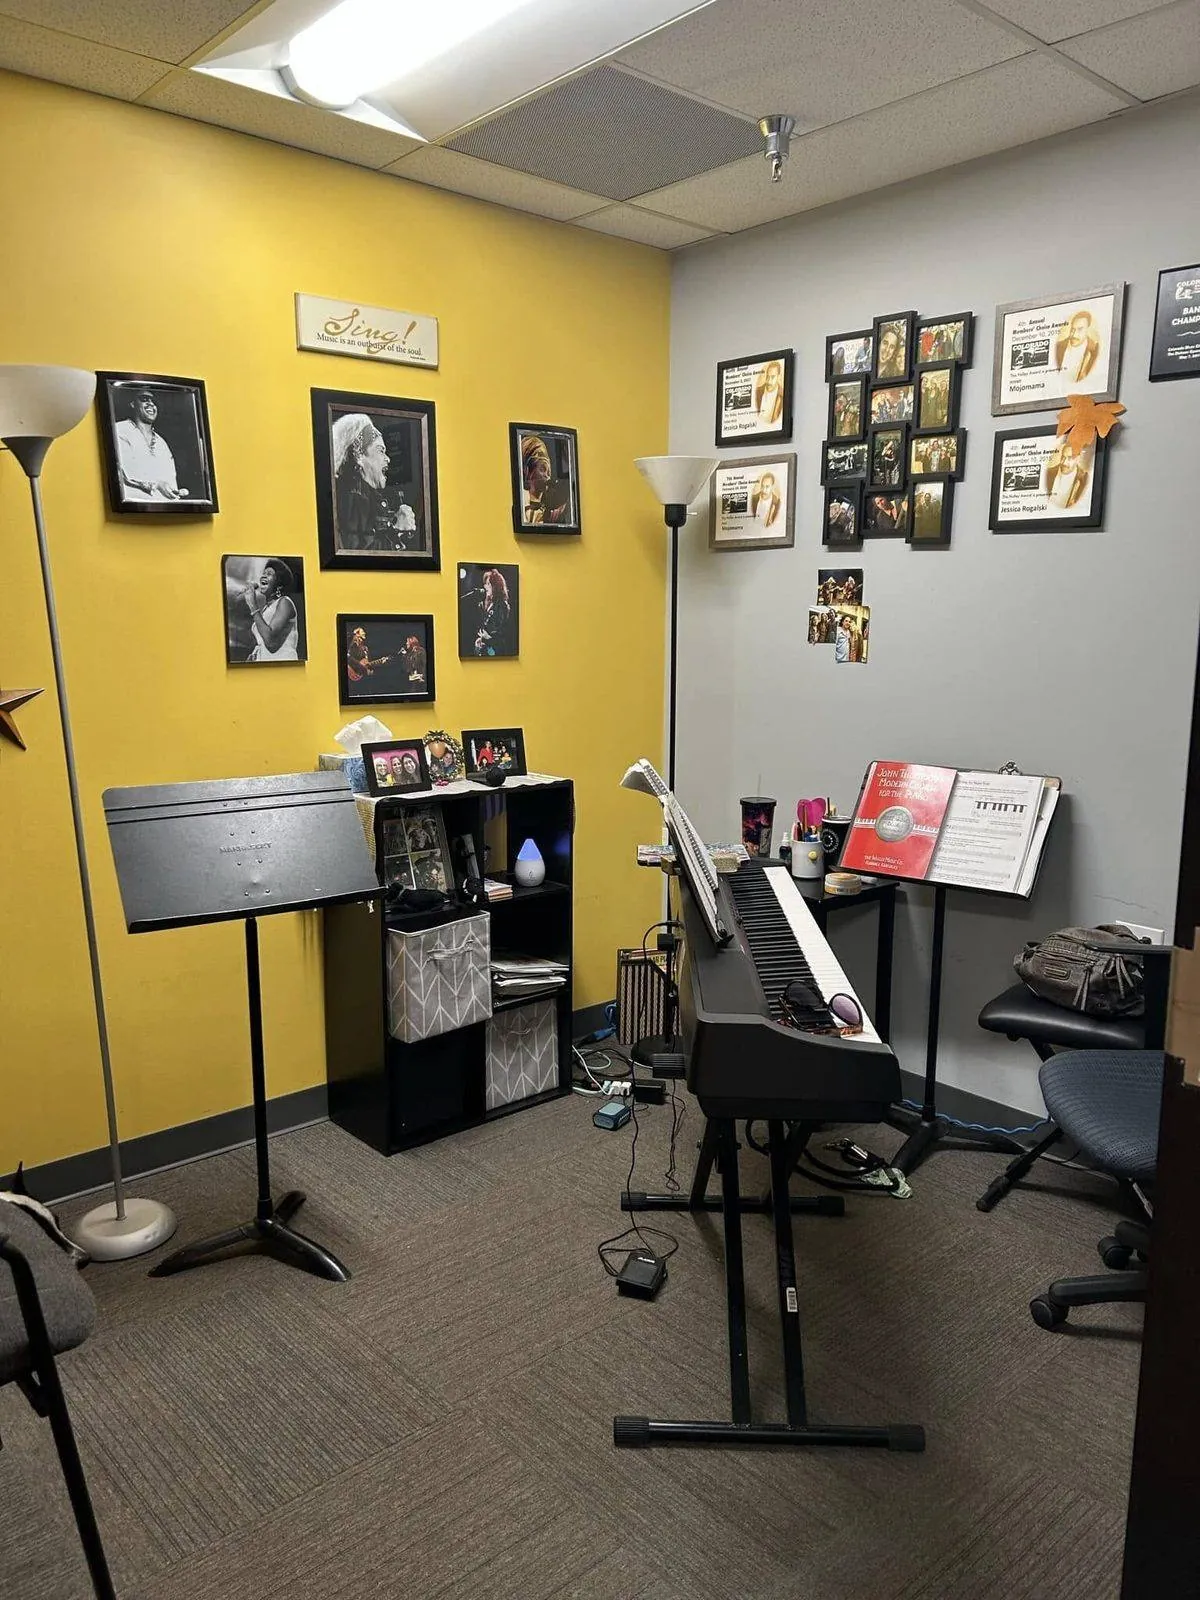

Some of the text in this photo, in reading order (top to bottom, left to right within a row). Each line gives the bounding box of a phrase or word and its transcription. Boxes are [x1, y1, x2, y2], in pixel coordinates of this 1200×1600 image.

[324, 308, 417, 354] Sing!
[316, 332, 338, 343] Music
[396, 345, 406, 354] the
[1022, 504, 1048, 512] Rogalski
